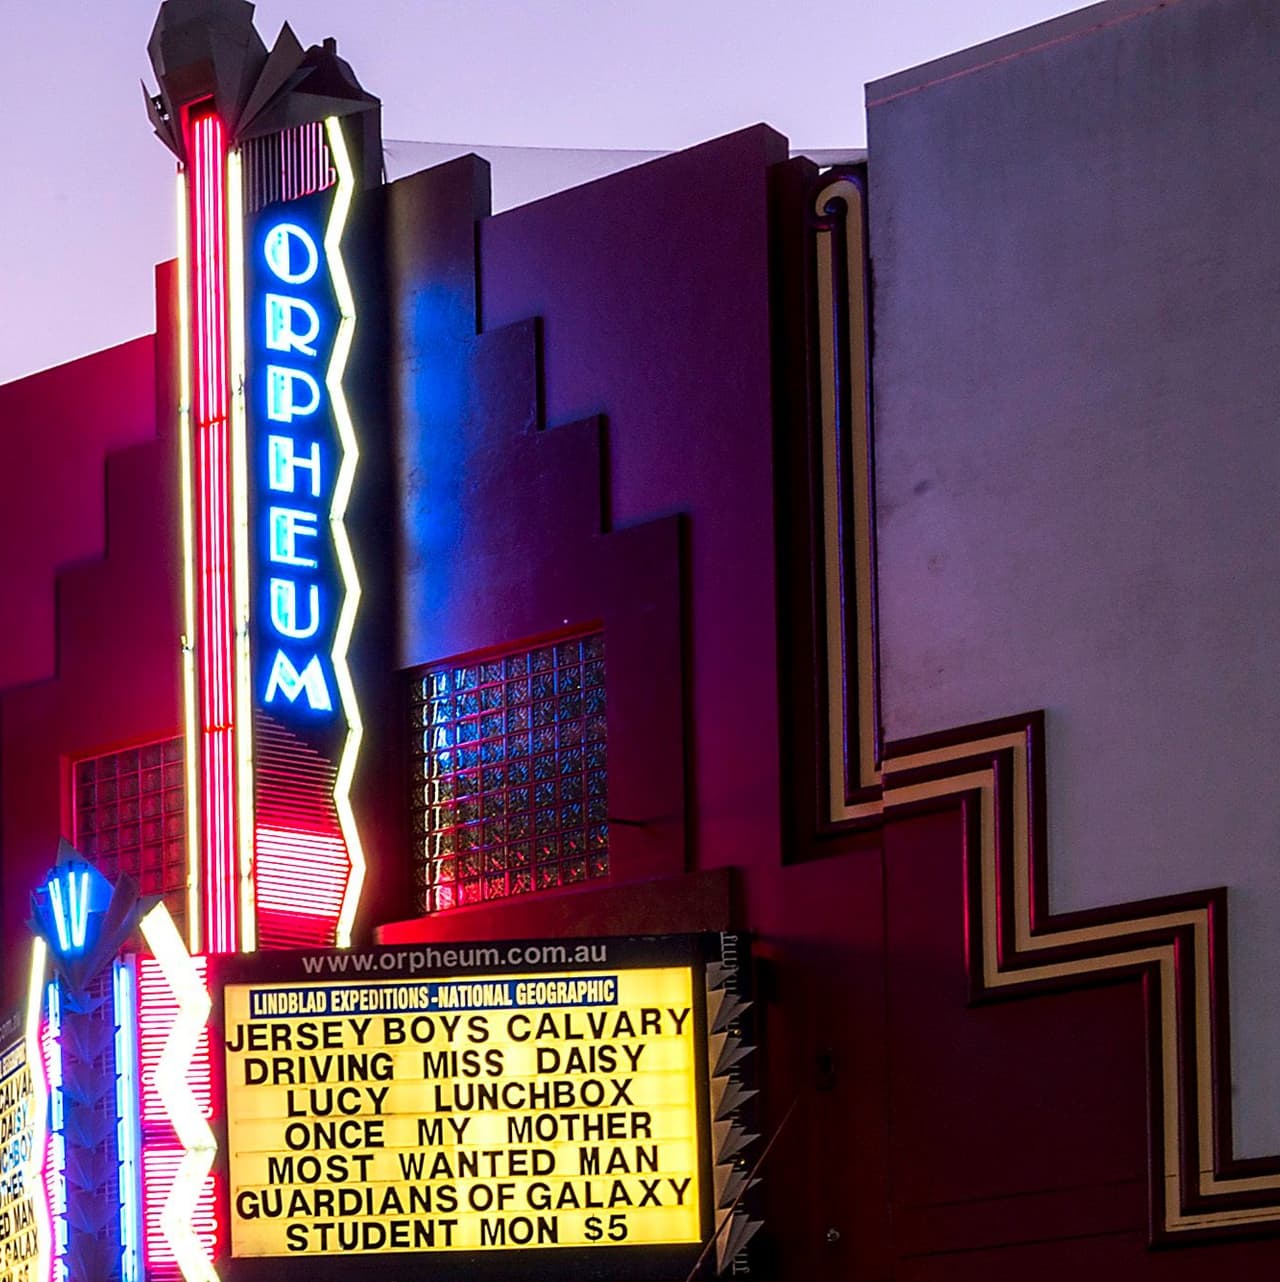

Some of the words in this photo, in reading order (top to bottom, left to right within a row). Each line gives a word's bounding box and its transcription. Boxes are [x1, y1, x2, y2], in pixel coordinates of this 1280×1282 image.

[263, 222, 333, 711] ORPHEUM
[303, 943, 607, 974] www.orpheum.com.au
[254, 991, 327, 1015] LINDBLAD
[516, 980, 614, 1003] GEOGRAPHIC
[226, 1016, 373, 1052] JERSEY
[384, 1015, 489, 1044] BOYS
[507, 1008, 691, 1042] CALVARY
[245, 1053, 395, 1086] DRIVING
[424, 1049, 504, 1079] MISS
[539, 1044, 645, 1074] DAISY
[288, 1087, 390, 1118] LUCY
[435, 1078, 634, 1112] LUNCHBOX
[285, 1120, 385, 1151] ONCE
[418, 1118, 471, 1147] MY
[508, 1112, 652, 1143] MOTHER
[268, 1154, 374, 1184] MOST
[399, 1149, 556, 1180] WANTED
[579, 1145, 659, 1176] MAN
[235, 1185, 458, 1219] GUARDIANS
[468, 1183, 516, 1212] OF
[527, 1178, 692, 1209] GALAXY
[287, 1219, 458, 1252] STUDENT
[480, 1216, 559, 1247] MON
[584, 1214, 628, 1242] $5
